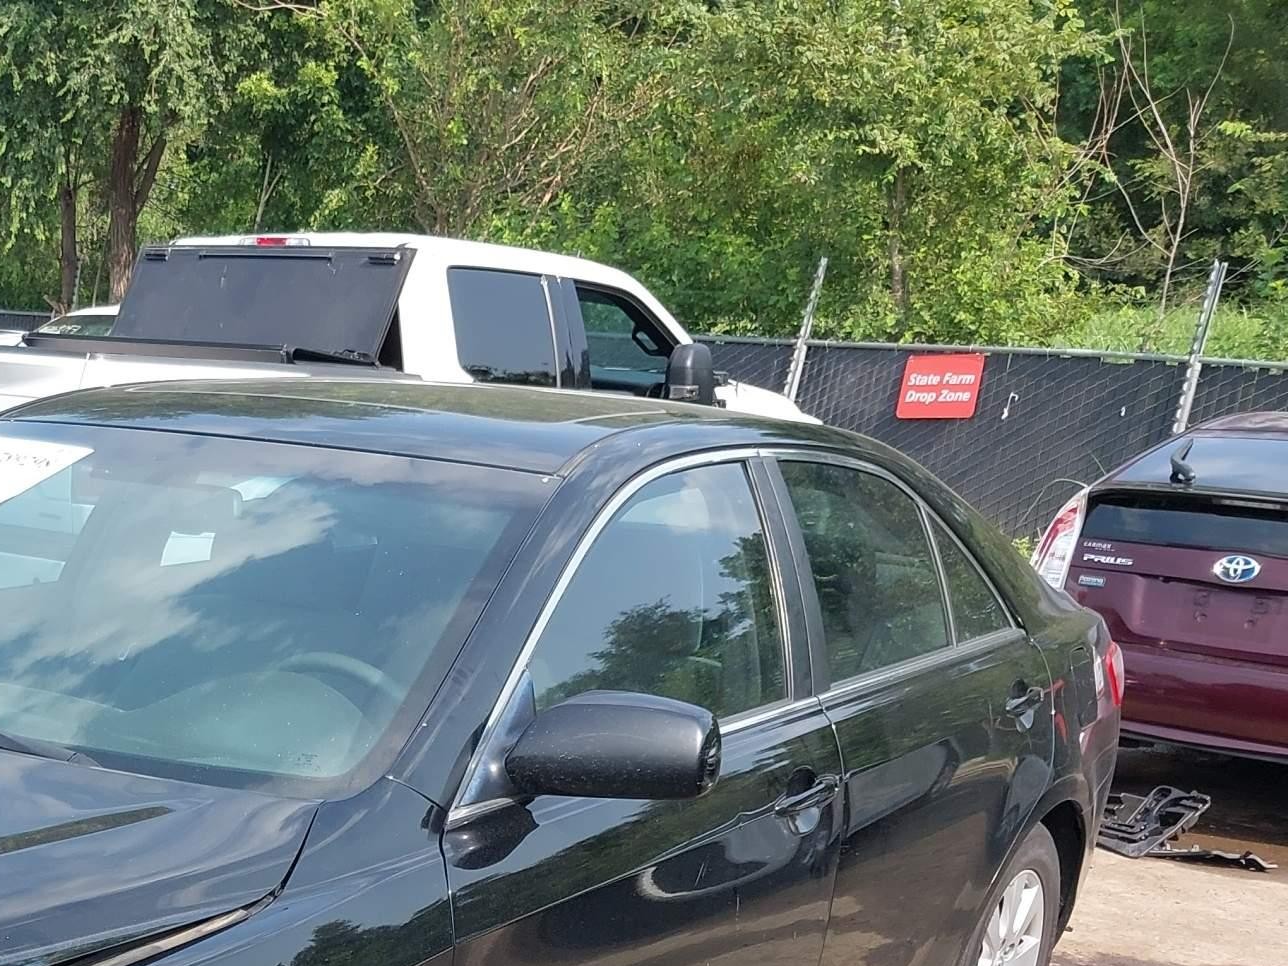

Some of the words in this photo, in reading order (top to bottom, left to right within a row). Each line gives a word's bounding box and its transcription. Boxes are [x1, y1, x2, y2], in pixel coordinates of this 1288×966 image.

[907, 372, 941, 386] State
[942, 372, 976, 385] Farm
[904, 389, 937, 405] Drop
[937, 389, 972, 402] Zone
[1083, 553, 1134, 566] PRIUS
